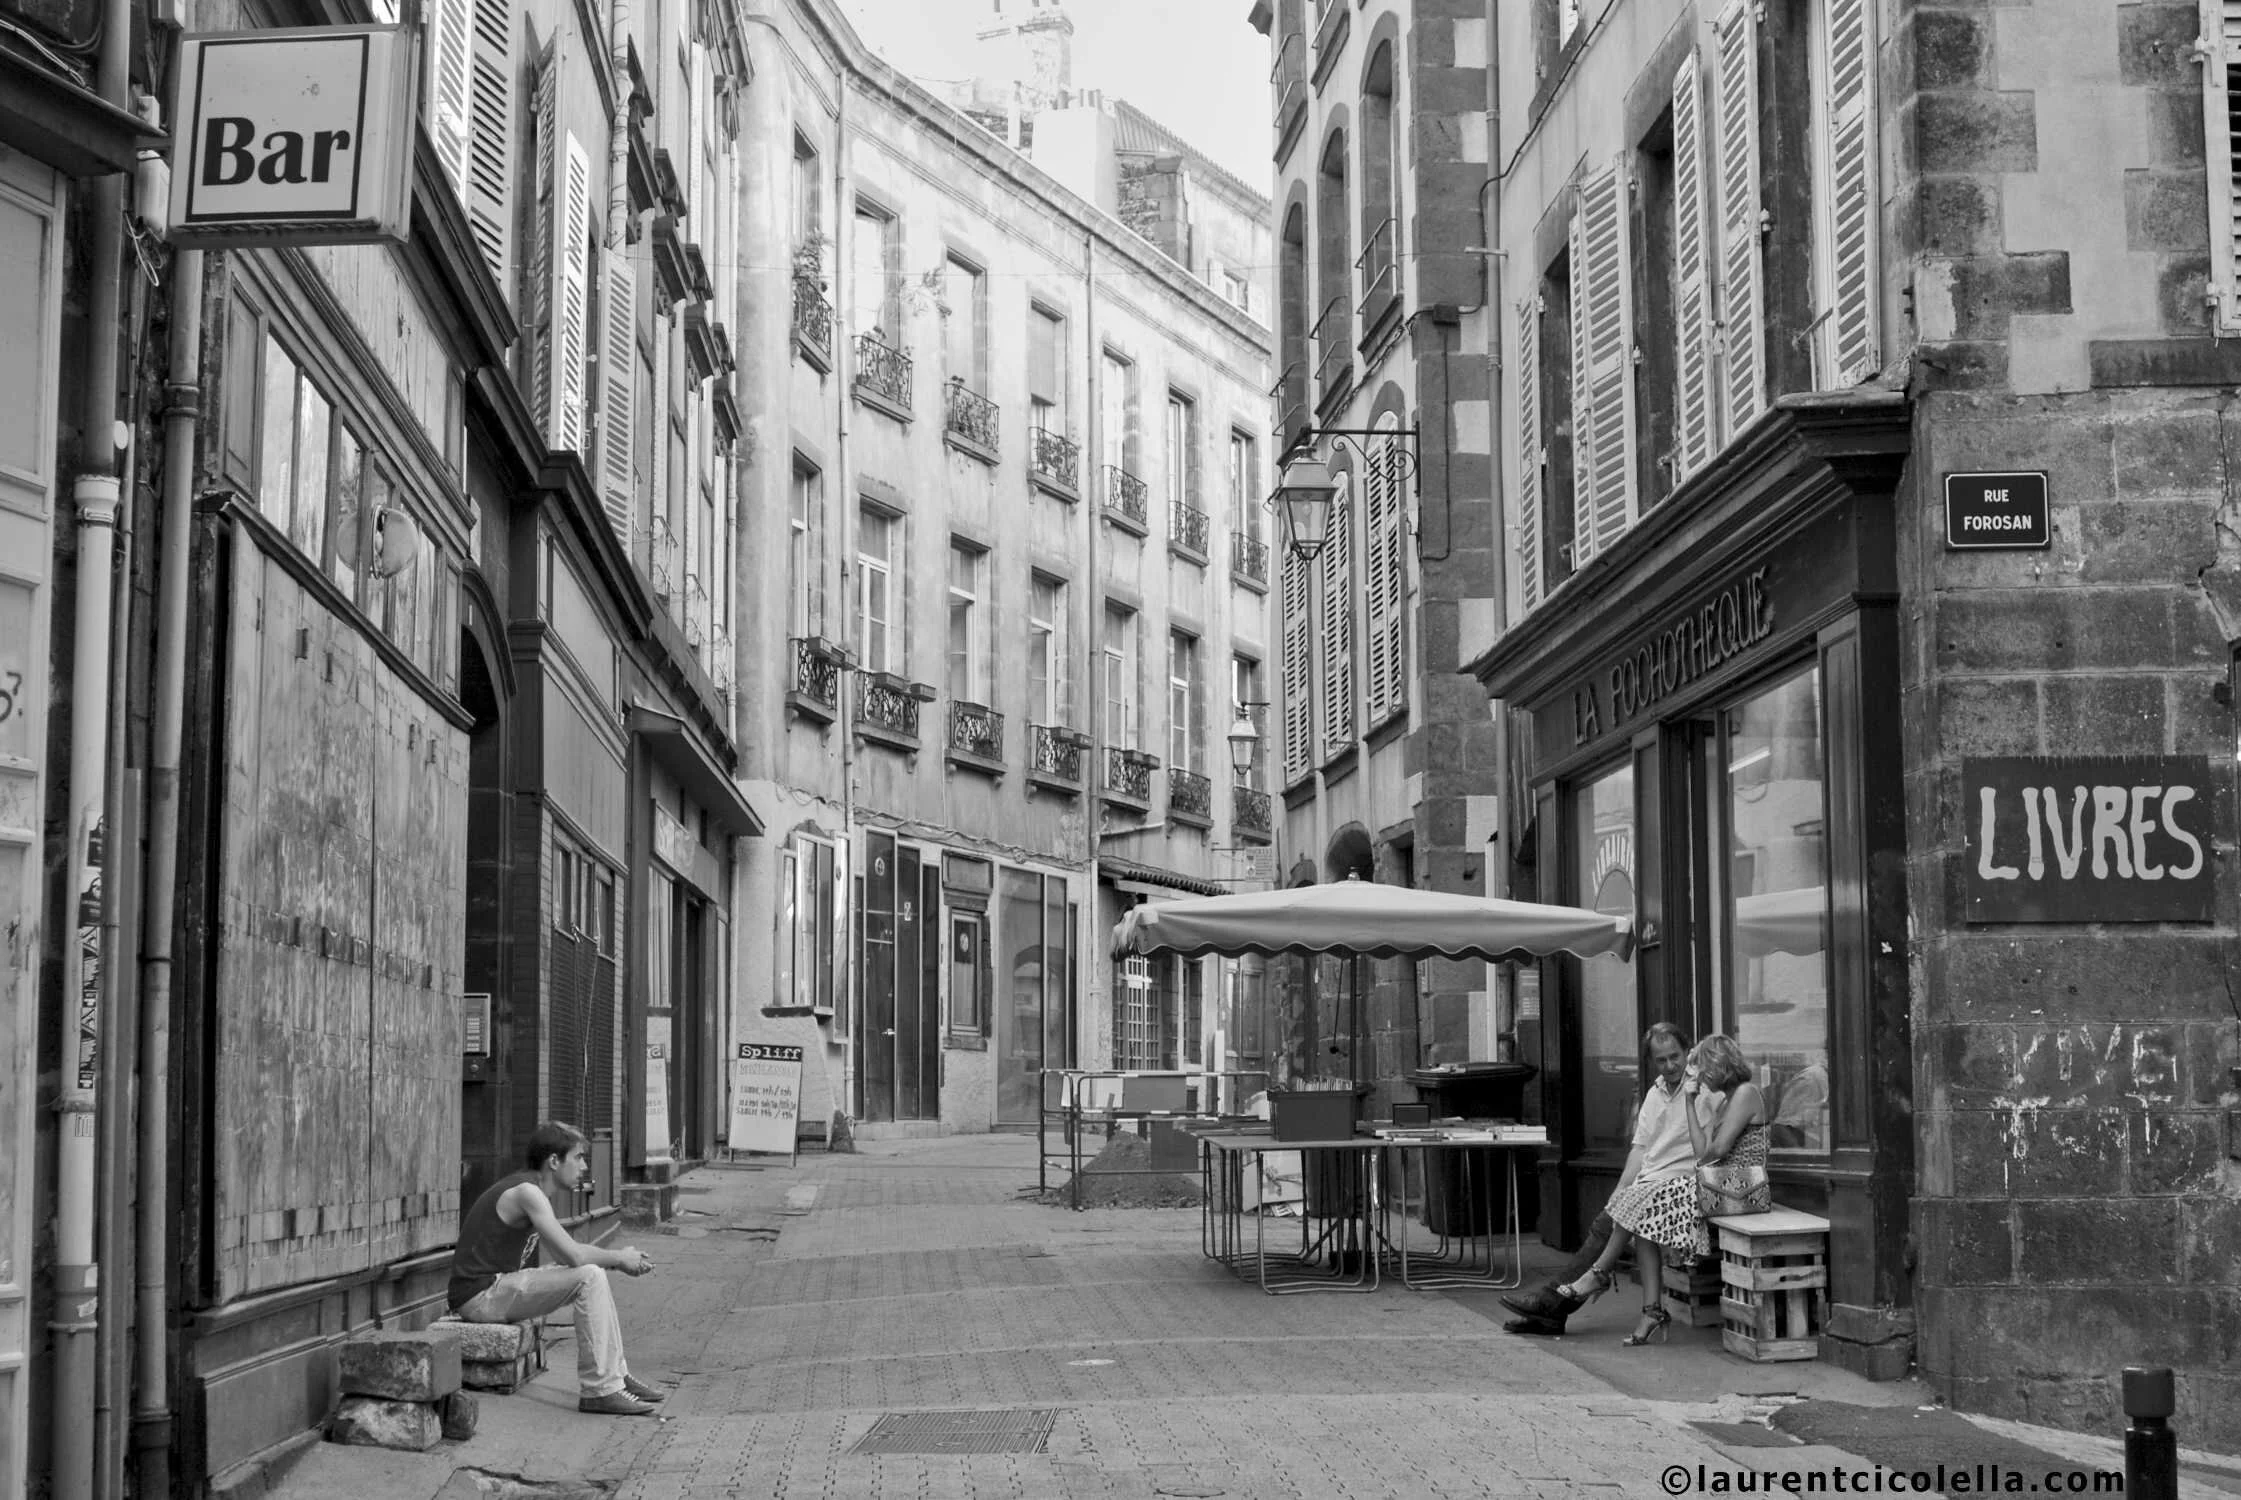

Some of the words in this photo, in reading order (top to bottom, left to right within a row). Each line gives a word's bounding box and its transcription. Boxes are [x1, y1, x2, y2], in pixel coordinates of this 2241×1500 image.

[201, 116, 351, 186] Bar
[1983, 489, 2010, 503] RUE
[1963, 514, 2032, 531] FOROSAN
[1573, 687, 1600, 746] LA
[1978, 785, 2203, 880] LIVRES
[741, 1045, 801, 1060] Spliff
